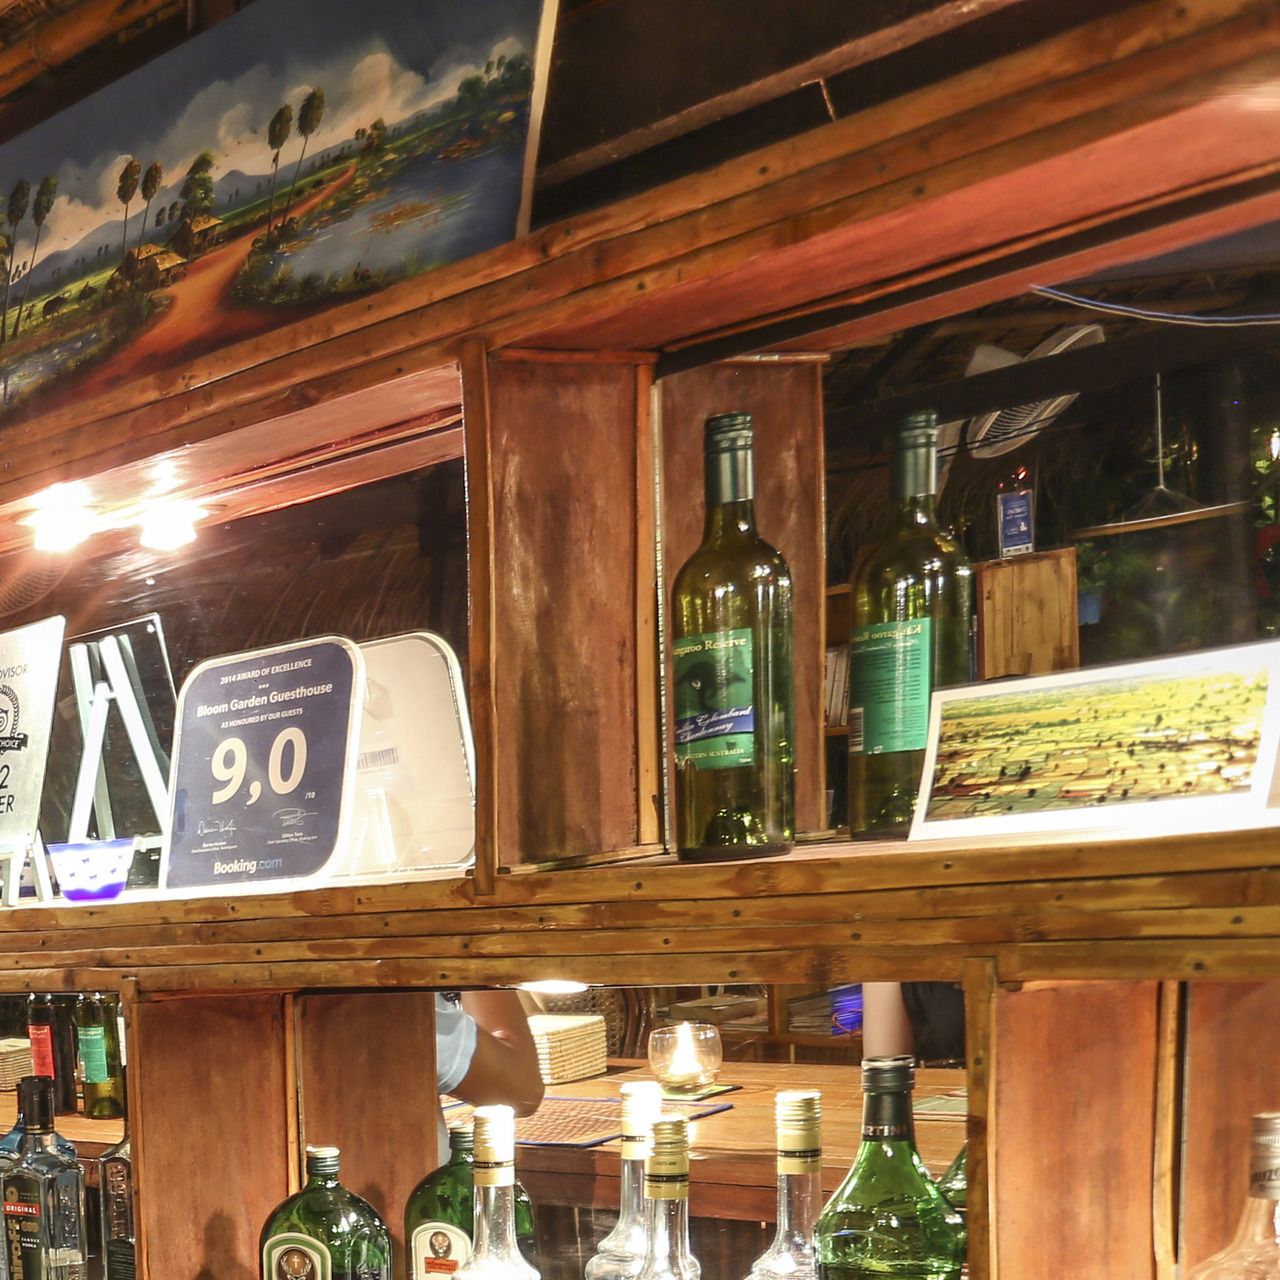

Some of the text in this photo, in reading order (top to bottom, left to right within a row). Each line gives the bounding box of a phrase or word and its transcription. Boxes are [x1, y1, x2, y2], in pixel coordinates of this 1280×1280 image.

[220, 658, 313, 685] 2014 AWARD OF EXCELLENCE
[197, 683, 333, 718] Bloom Garden Guesthouse
[220, 721, 229, 729] AS
[229, 716, 260, 728] HONOURED
[268, 712, 281, 720] OUR
[281, 708, 303, 717] GUESTS
[211, 727, 308, 805] 9,0
[213, 858, 283, 875] Booking.com
[5, 1204, 37, 1214] ORIGINAL
